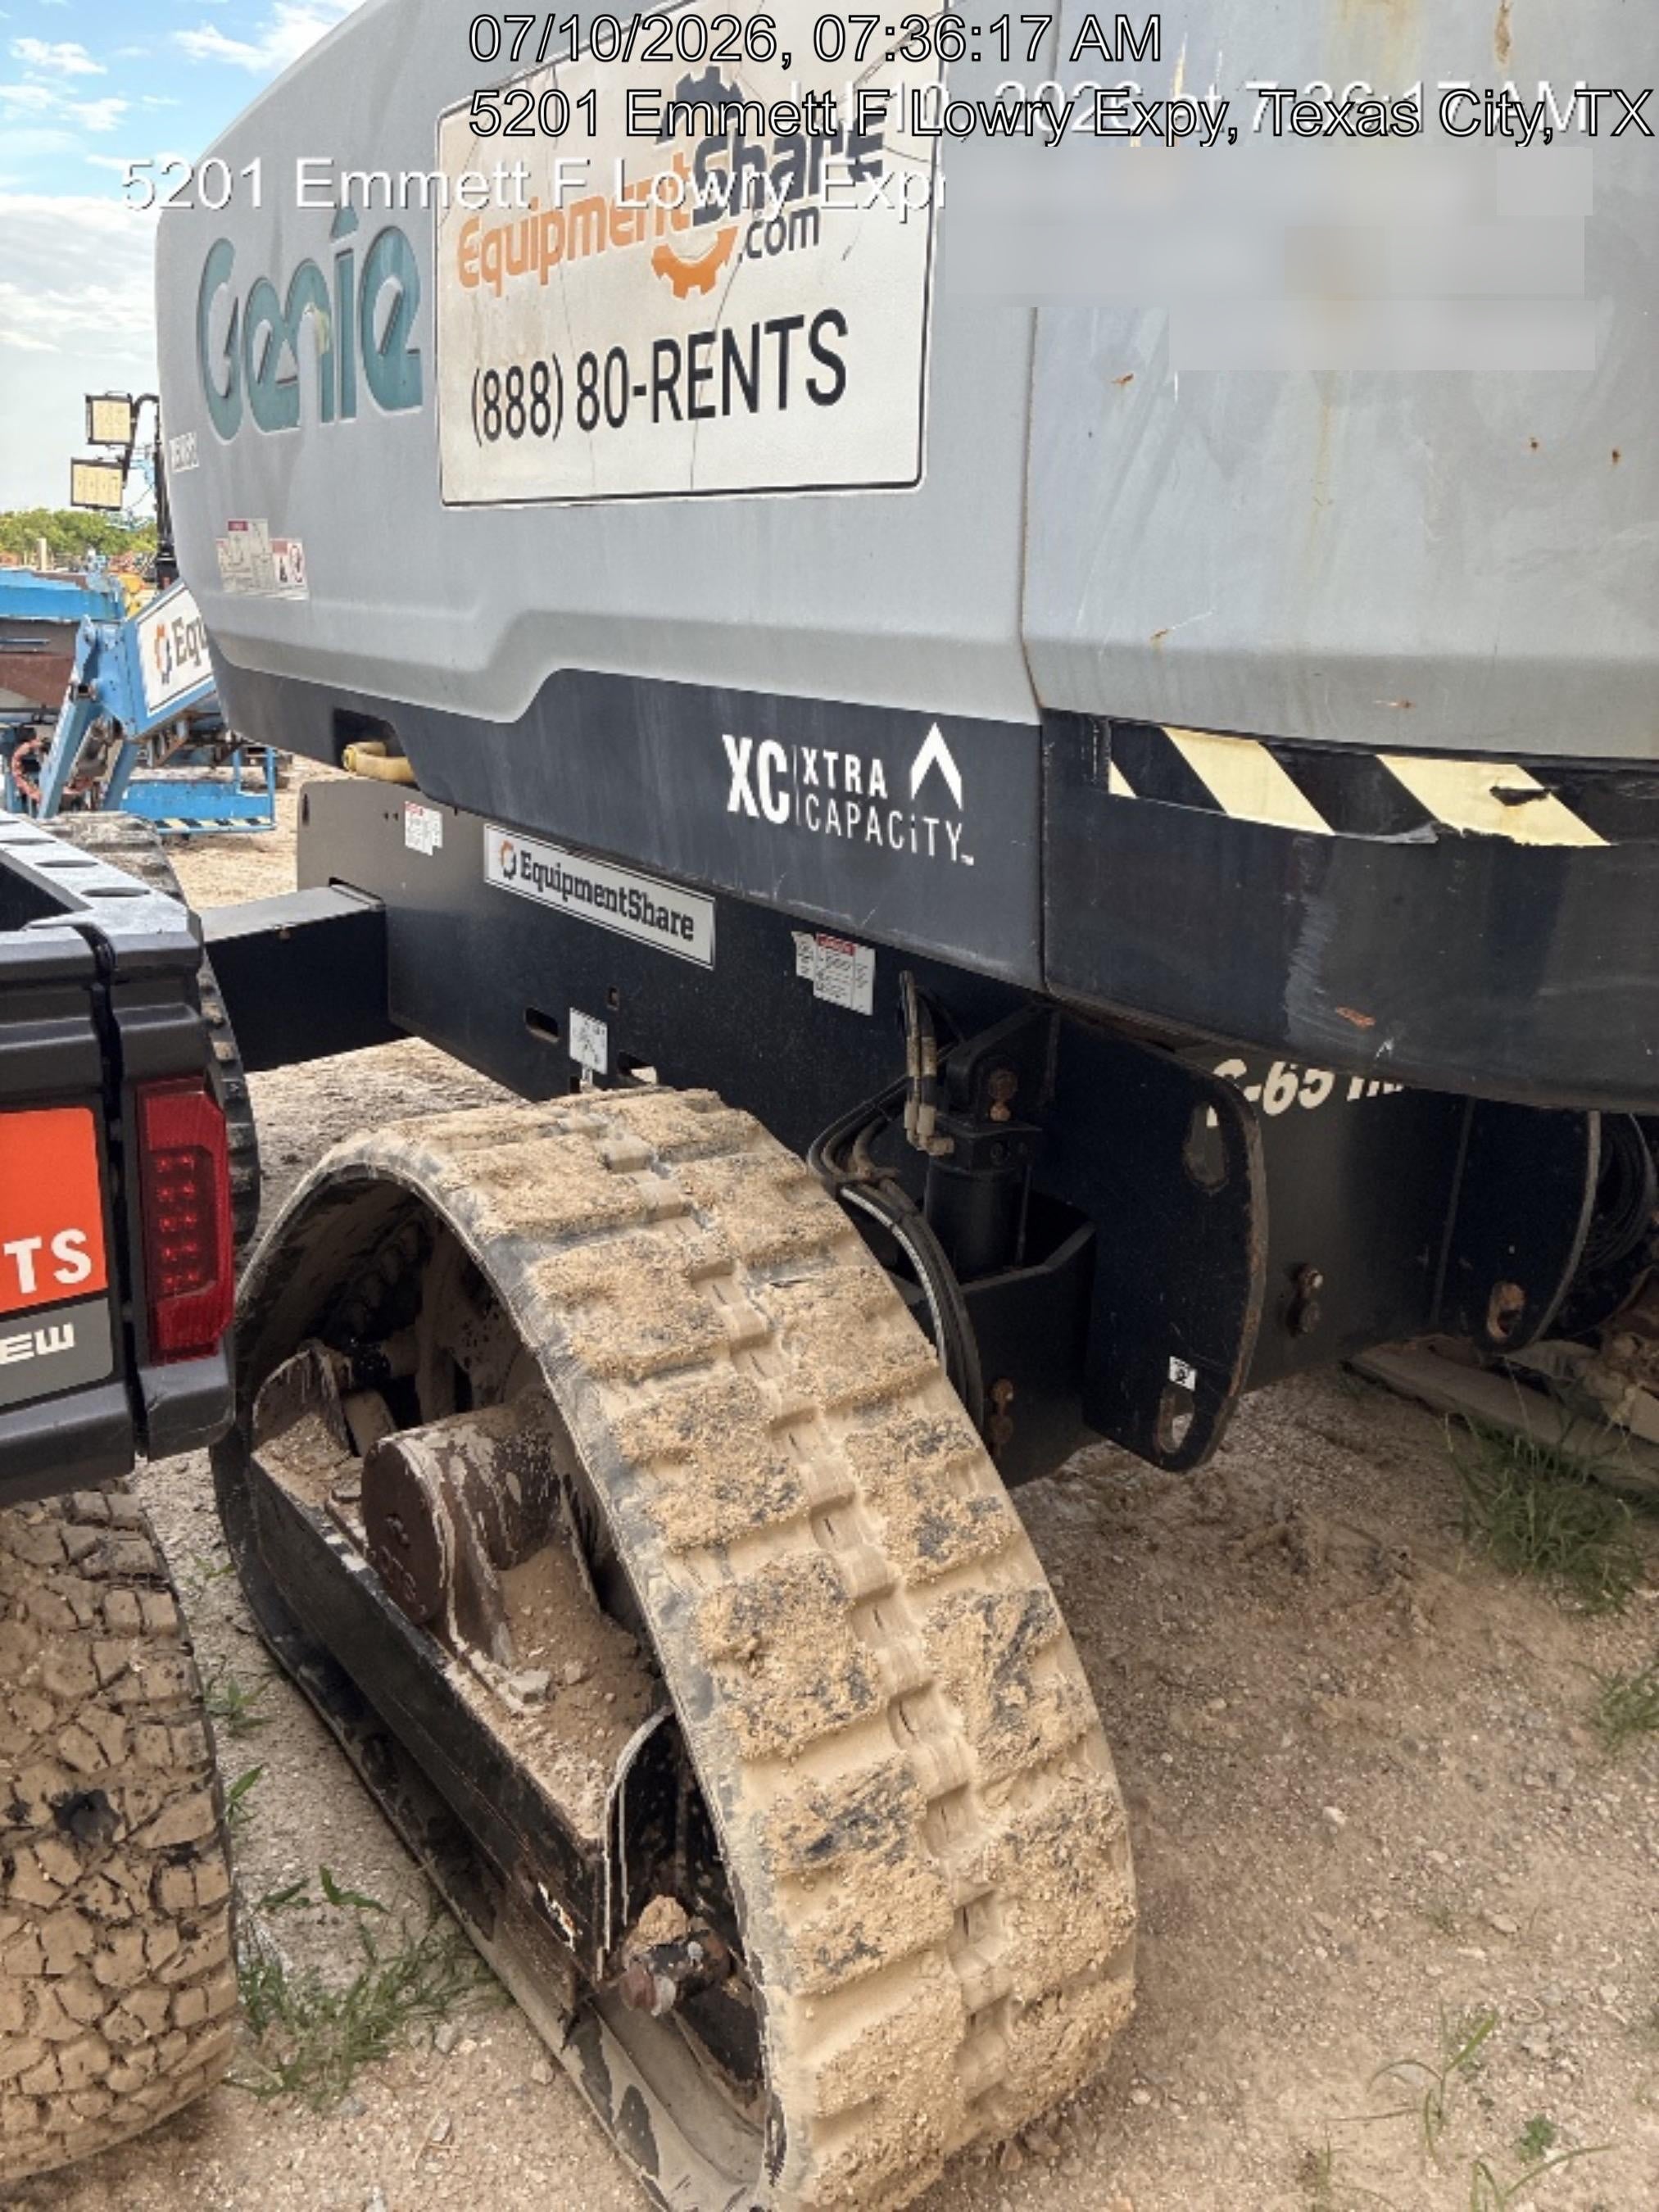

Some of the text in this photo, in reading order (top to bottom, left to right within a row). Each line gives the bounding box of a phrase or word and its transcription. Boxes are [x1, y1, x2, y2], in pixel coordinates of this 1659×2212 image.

[195, 193, 424, 442] Genie
[471, 307, 849, 447] (888) 80-RENTS
[722, 733, 791, 824] XC
[800, 746, 889, 800] XTRA
[519, 850, 695, 942] EquipmentShare
